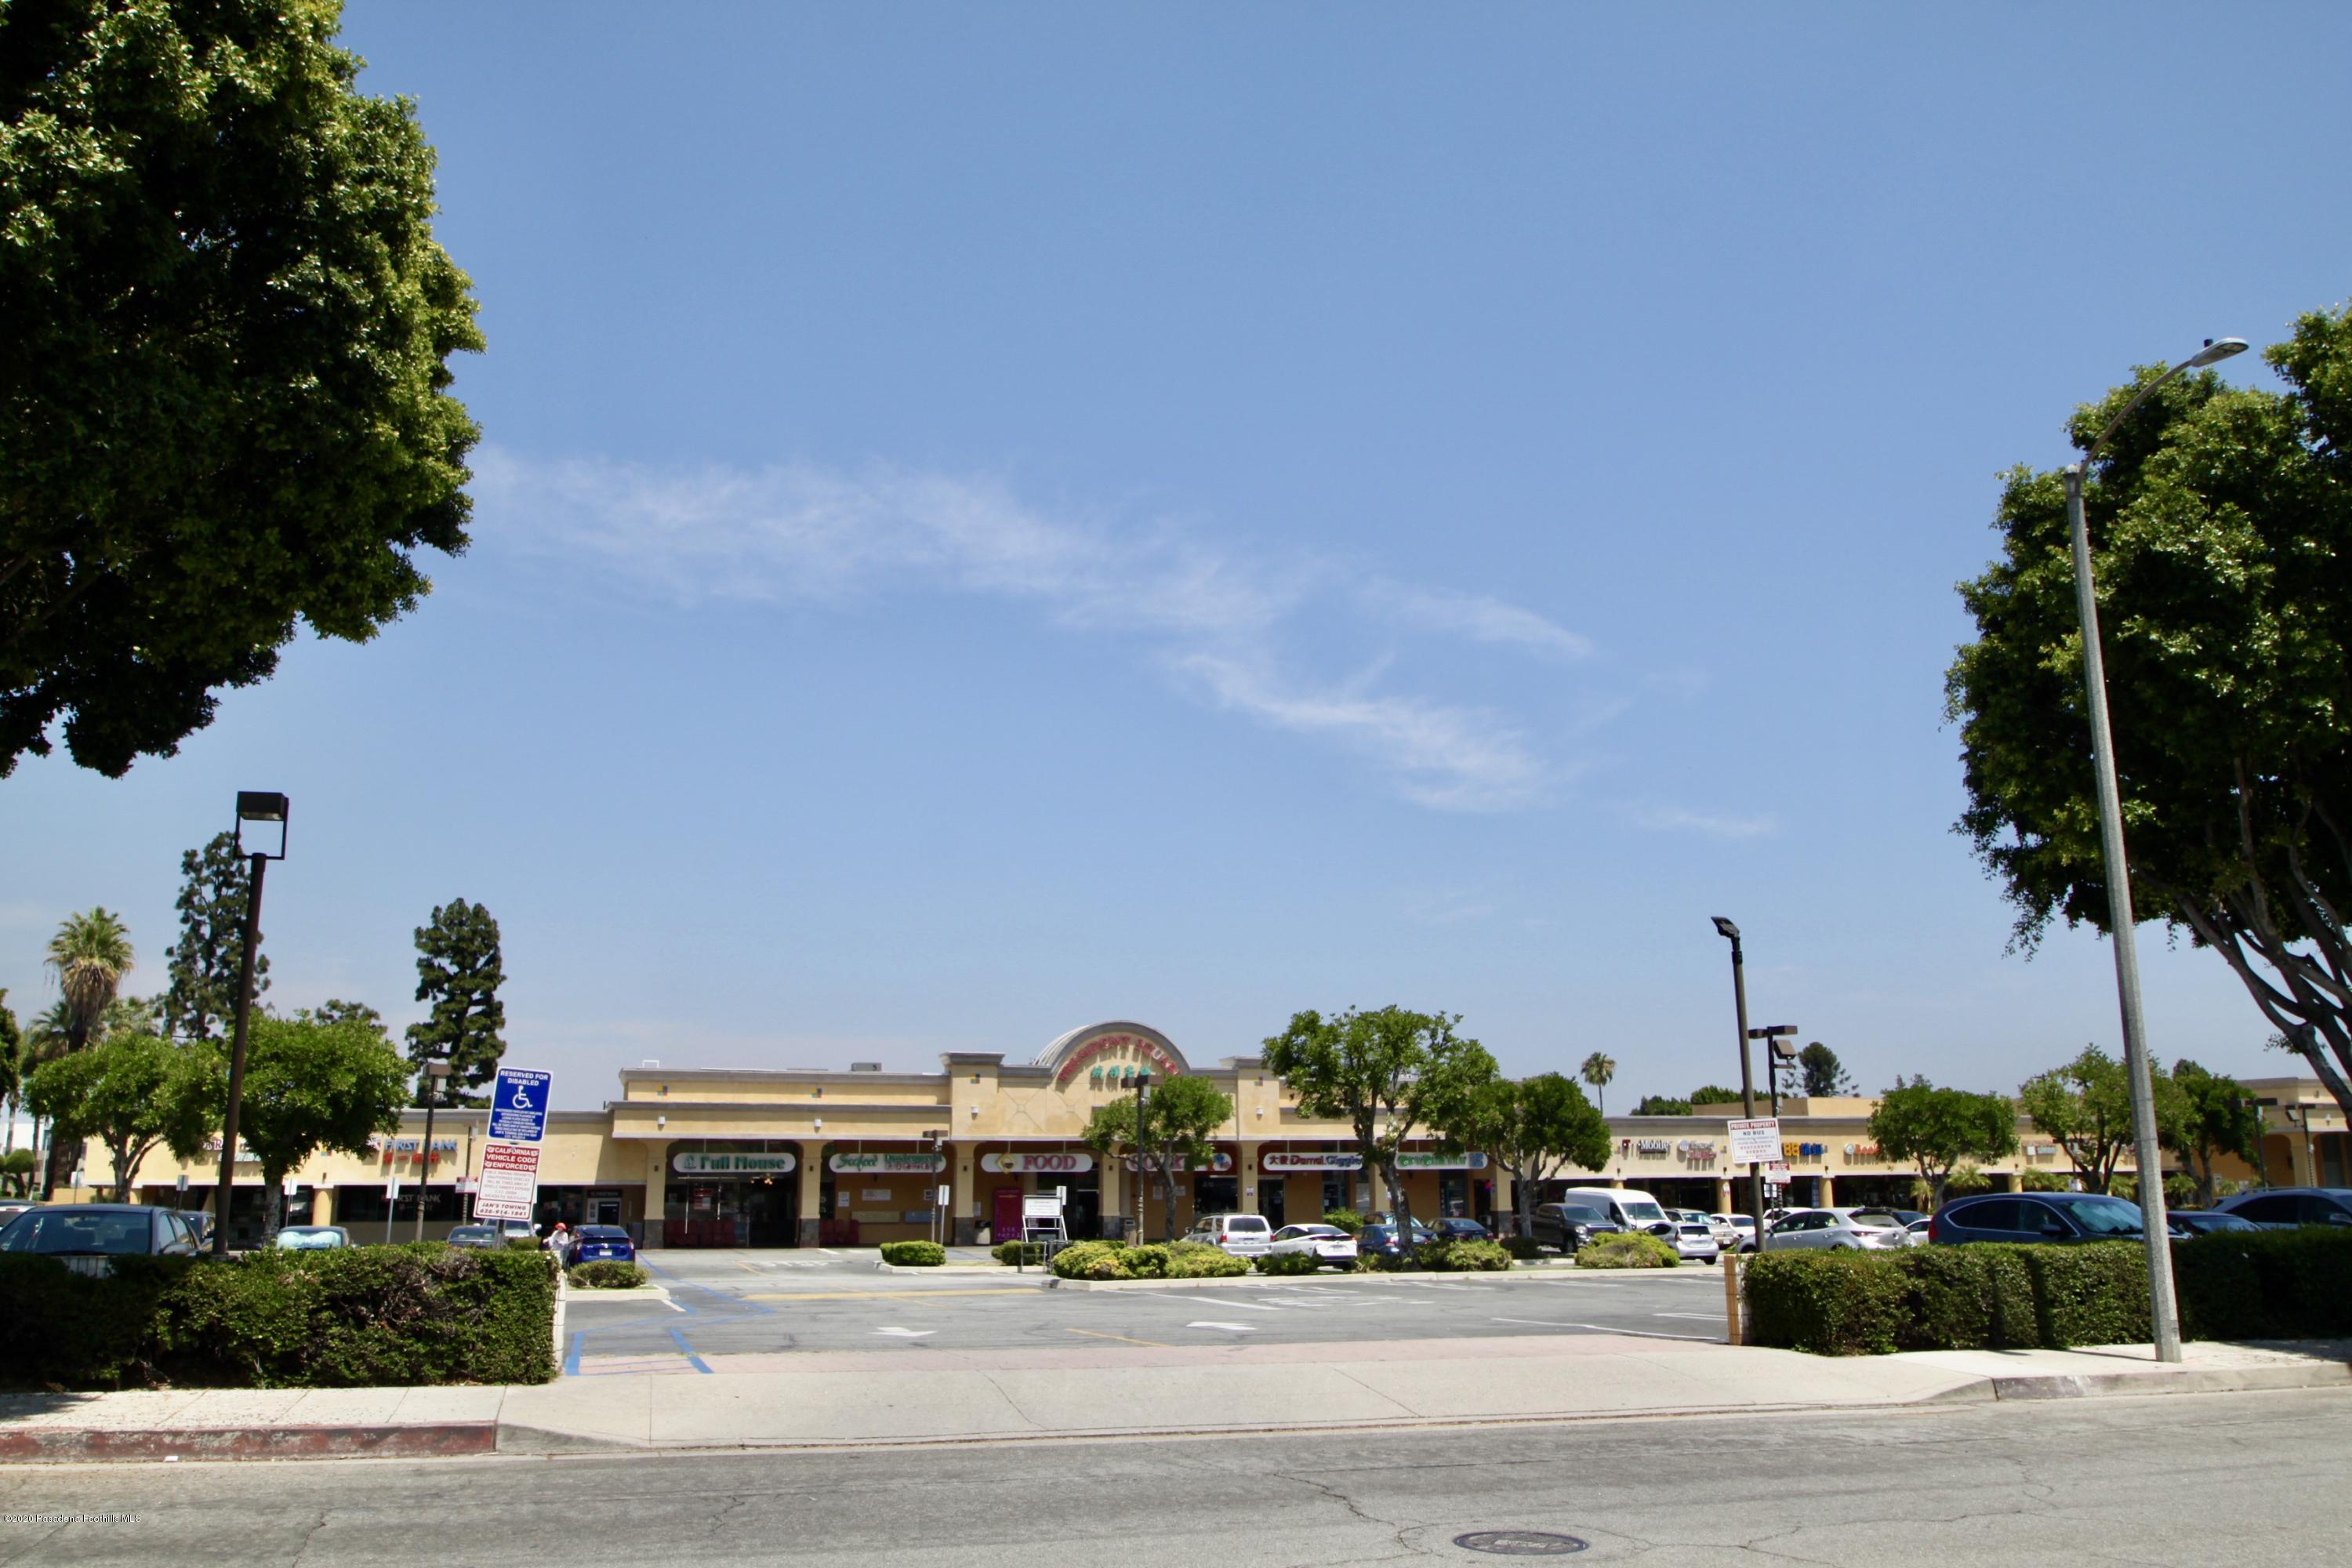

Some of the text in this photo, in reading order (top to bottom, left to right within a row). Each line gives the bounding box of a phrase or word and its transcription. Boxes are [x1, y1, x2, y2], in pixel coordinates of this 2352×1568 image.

[500, 1070, 534, 1079] RESERVED
[507, 1077, 539, 1087] DISABLED
[1750, 1120, 1775, 1129] PROPERTY
[384, 1138, 458, 1151] FIRST ANK
[494, 1147, 531, 1156] CALIFORNIA
[486, 1153, 516, 1162] VEHICLE
[700, 1155, 786, 1170] Full House
[1022, 1154, 1077, 1171] FOOD
[492, 1160, 528, 1170] ENFORCED
